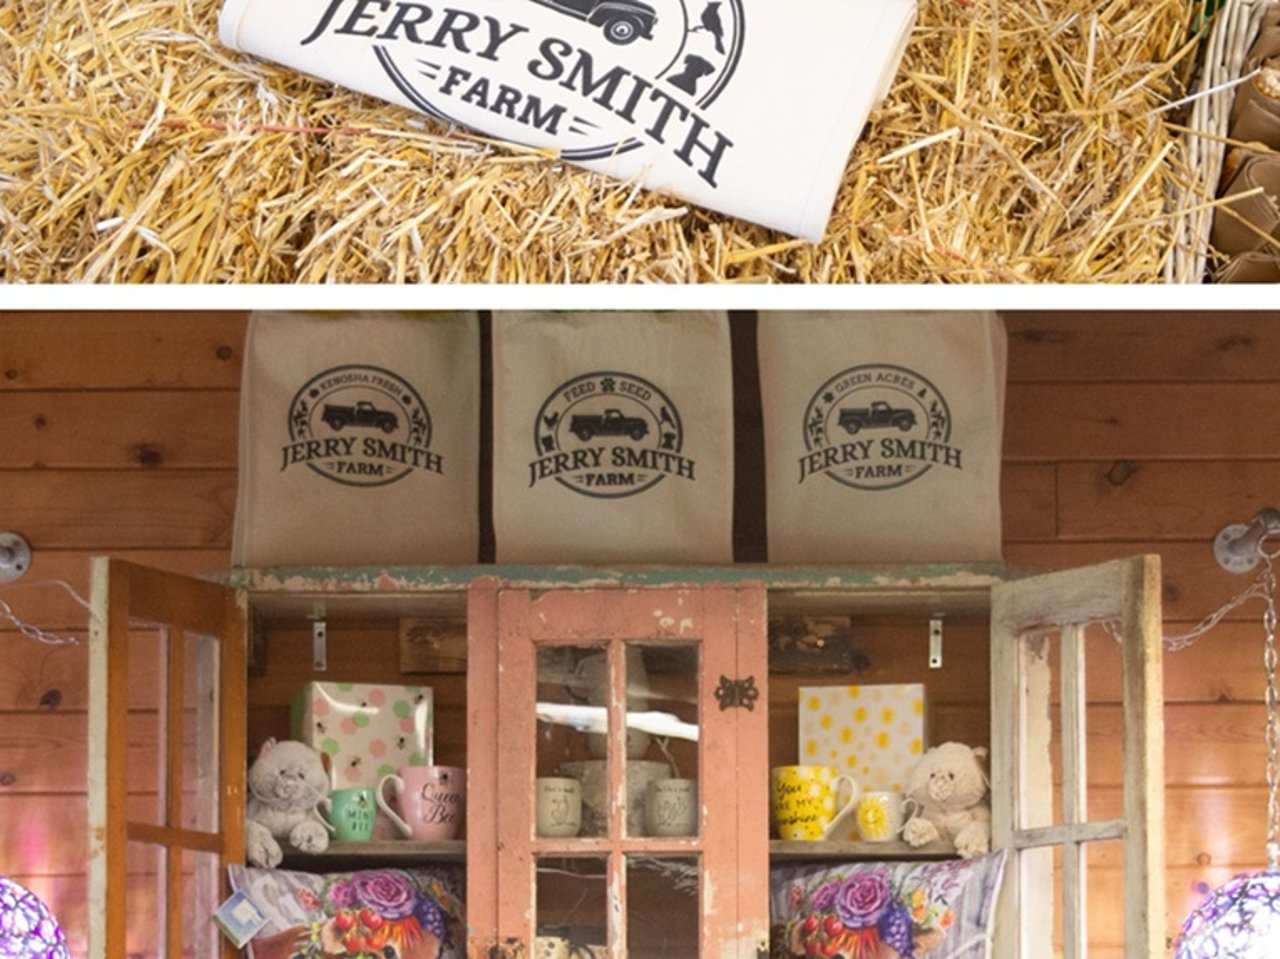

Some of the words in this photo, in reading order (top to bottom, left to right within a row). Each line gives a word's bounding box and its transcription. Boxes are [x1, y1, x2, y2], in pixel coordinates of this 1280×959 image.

[300, 0, 529, 62] JERRY
[526, 37, 734, 189] SMITH
[438, 65, 568, 136] FARM
[563, 381, 597, 402] FEED
[619, 381, 652, 402] SEED
[835, 372, 872, 394] GREEN
[876, 372, 916, 390] ACRES
[279, 437, 358, 472] JERRY
[362, 437, 444, 475] SMITH
[336, 461, 384, 476] FARM
[528, 447, 607, 489] JERRY
[611, 446, 696, 481] SMITH
[797, 439, 875, 485] JERRY
[880, 437, 963, 470] SMITH
[585, 473, 635, 486] FARM
[855, 464, 903, 479] FARM
